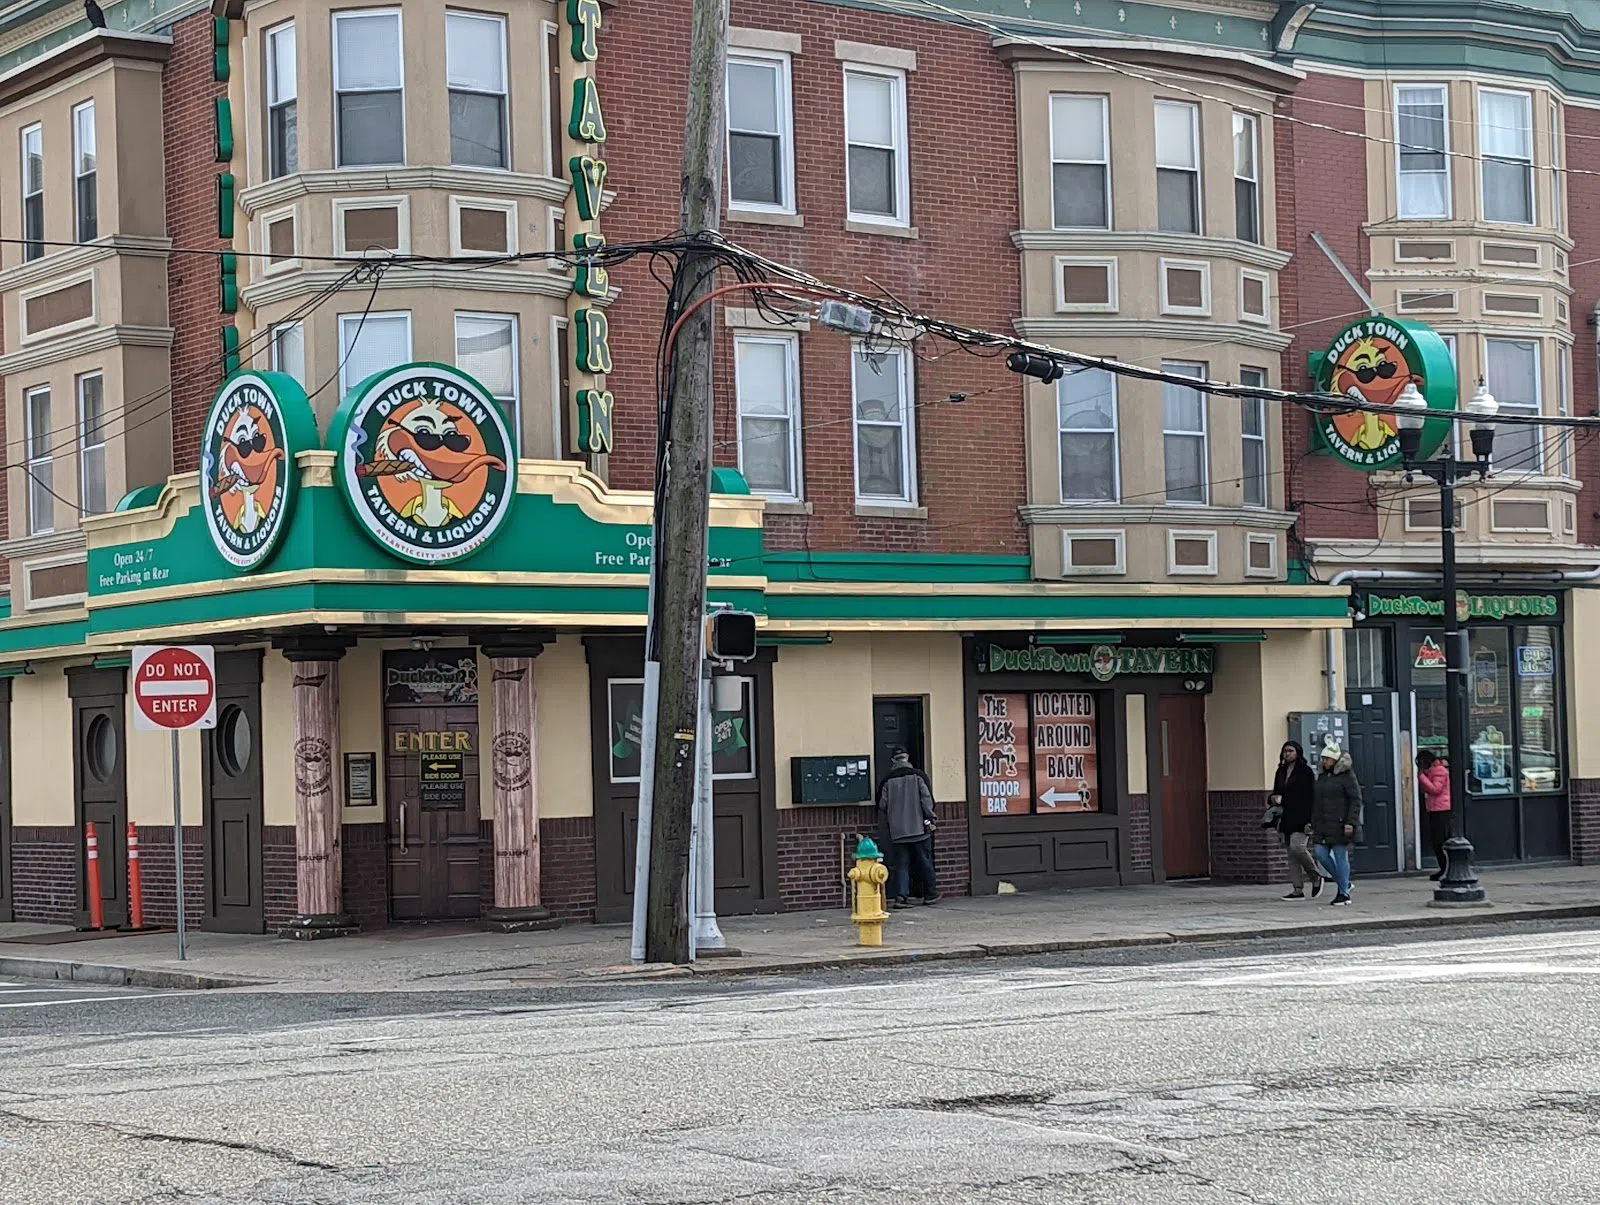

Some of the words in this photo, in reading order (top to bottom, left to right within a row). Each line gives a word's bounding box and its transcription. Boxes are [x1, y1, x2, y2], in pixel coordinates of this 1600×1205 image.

[572, 0, 614, 454] TAVERN
[1327, 324, 1363, 364] DUCK
[1366, 322, 1409, 350] TOWN
[216, 393, 242, 437] DUCK
[243, 388, 273, 420] TOWN
[376, 381, 428, 417] DUCK
[432, 382, 488, 425] TOWN
[1325, 423, 1363, 463] TAVERN
[1365, 453, 1375, 464] &
[1376, 440, 1401, 462] LIQ
[215, 504, 244, 549] TAVERN
[243, 537, 251, 550] &
[251, 486, 282, 549] LIQUORS
[367, 485, 418, 540] TAVERN
[420, 531, 434, 543] &
[437, 492, 497, 543] LIQUORS
[376, 528, 414, 555] ATLANTIC
[625, 532, 653, 550] Ope
[113, 553, 133, 568] Open
[135, 548, 154, 563] 24/7
[595, 552, 624, 565] Free
[629, 552, 651, 566] Par
[99, 574, 114, 587] Free
[116, 570, 142, 586] Parking
[143, 567, 151, 581] in
[152, 567, 170, 580] Rear
[1369, 594, 1445, 617] DuckTow
[1469, 595, 1557, 619] LIQUORS
[145, 664, 166, 677] DO
[173, 663, 201, 676] NOT
[1118, 647, 1214, 673] TAVERN
[152, 699, 198, 713] ENTER
[984, 694, 1007, 717] THE
[1034, 693, 1093, 717] LOCATED
[395, 731, 472, 751] ENTER
[1036, 724, 1092, 748] AROUND
[1047, 755, 1085, 779] BACK
[421, 782, 448, 790] PLEASE
[449, 782, 464, 790] USE
[440, 792, 463, 800] DOOR
[987, 798, 1008, 813] BAR
